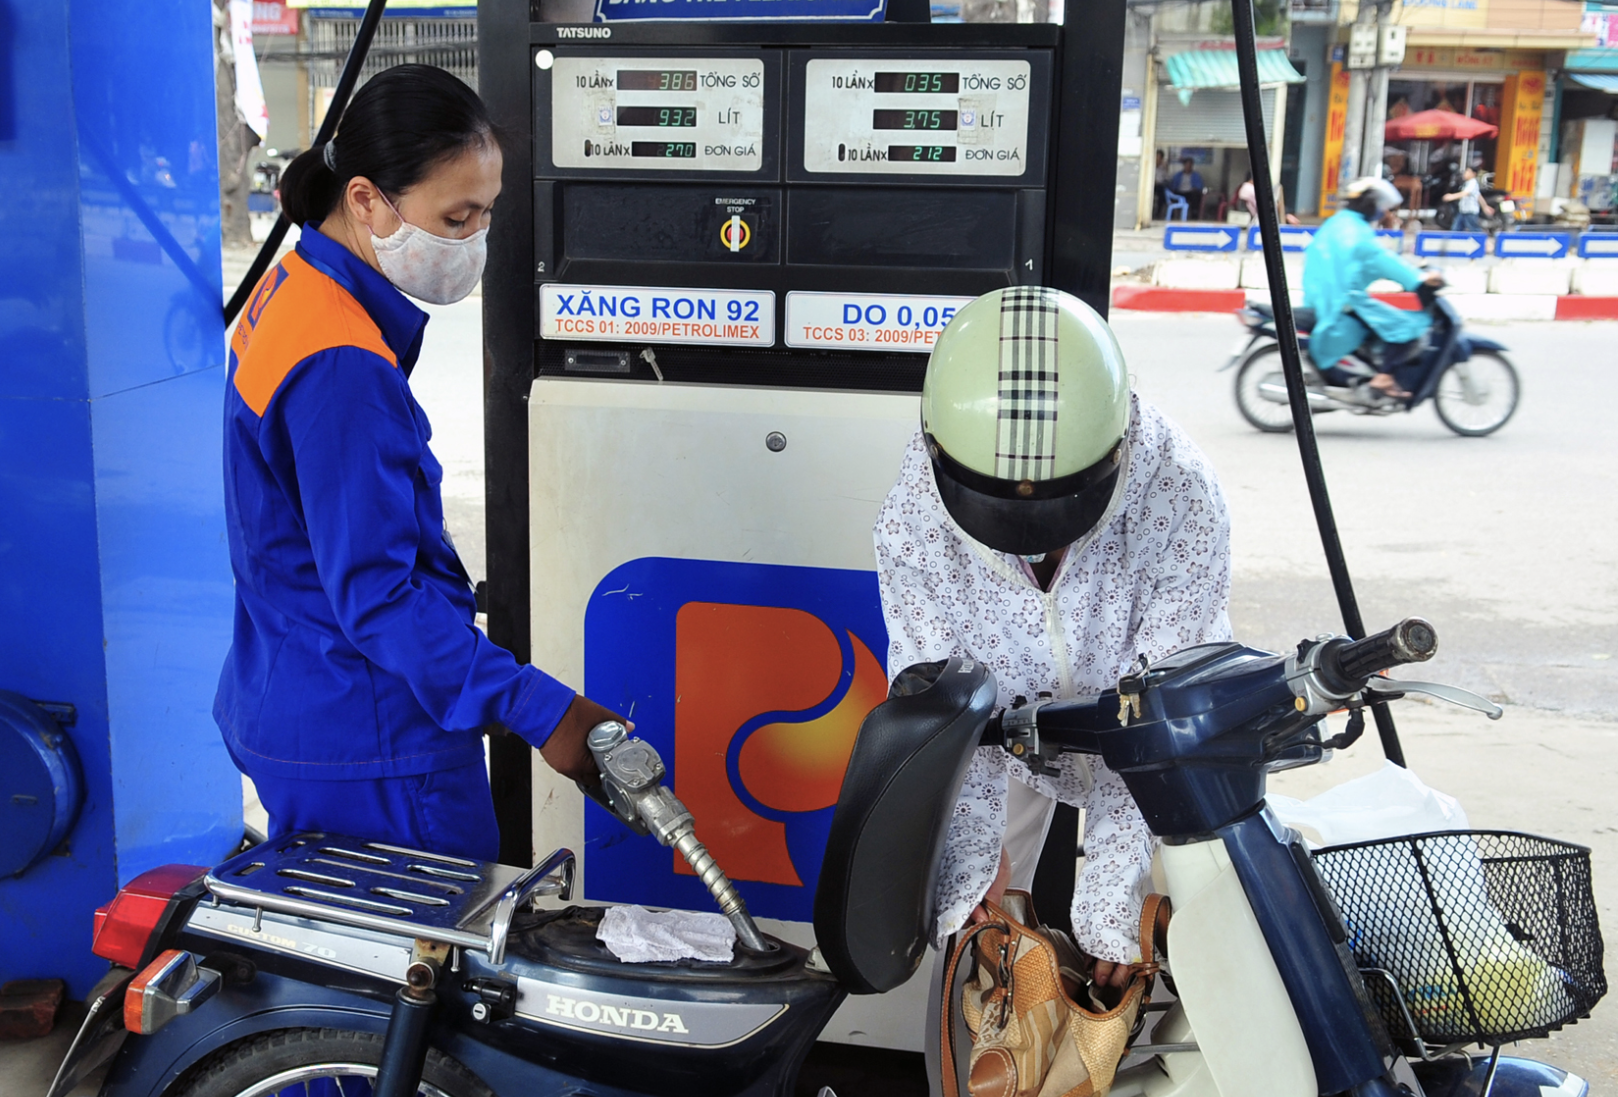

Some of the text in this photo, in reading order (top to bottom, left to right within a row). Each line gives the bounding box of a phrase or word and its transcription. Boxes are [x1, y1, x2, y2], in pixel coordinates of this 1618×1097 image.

[556, 27, 612, 39] TATSUNO
[576, 75, 587, 88] 10
[700, 71, 762, 88] TỔNG SỐ
[832, 76, 843, 89] 10
[904, 74, 942, 91] 035
[962, 73, 1028, 90] TỔNG SỐ
[659, 109, 695, 126] 932
[718, 107, 741, 125] LÍT
[981, 110, 1005, 128] LÍT
[590, 144, 601, 156] 10
[734, 143, 757, 157] GIÁ
[848, 148, 858, 161] 10
[913, 146, 943, 160] 212
[996, 147, 1020, 161] GIÁ
[714, 197, 757, 206] EMERGENCY
[726, 205, 745, 213] STOP
[537, 261, 546, 273] 2
[556, 290, 760, 322] XĂNG RON 92
[843, 303, 956, 330] DO 0,05
[555, 319, 760, 339] TCCS 01: 2009/PETROLIMEX
[803, 326, 844, 341] TCCS
[850, 327, 870, 342] 03:
[227, 924, 337, 959] CUSTOM 70
[545, 994, 690, 1034] HONDA
